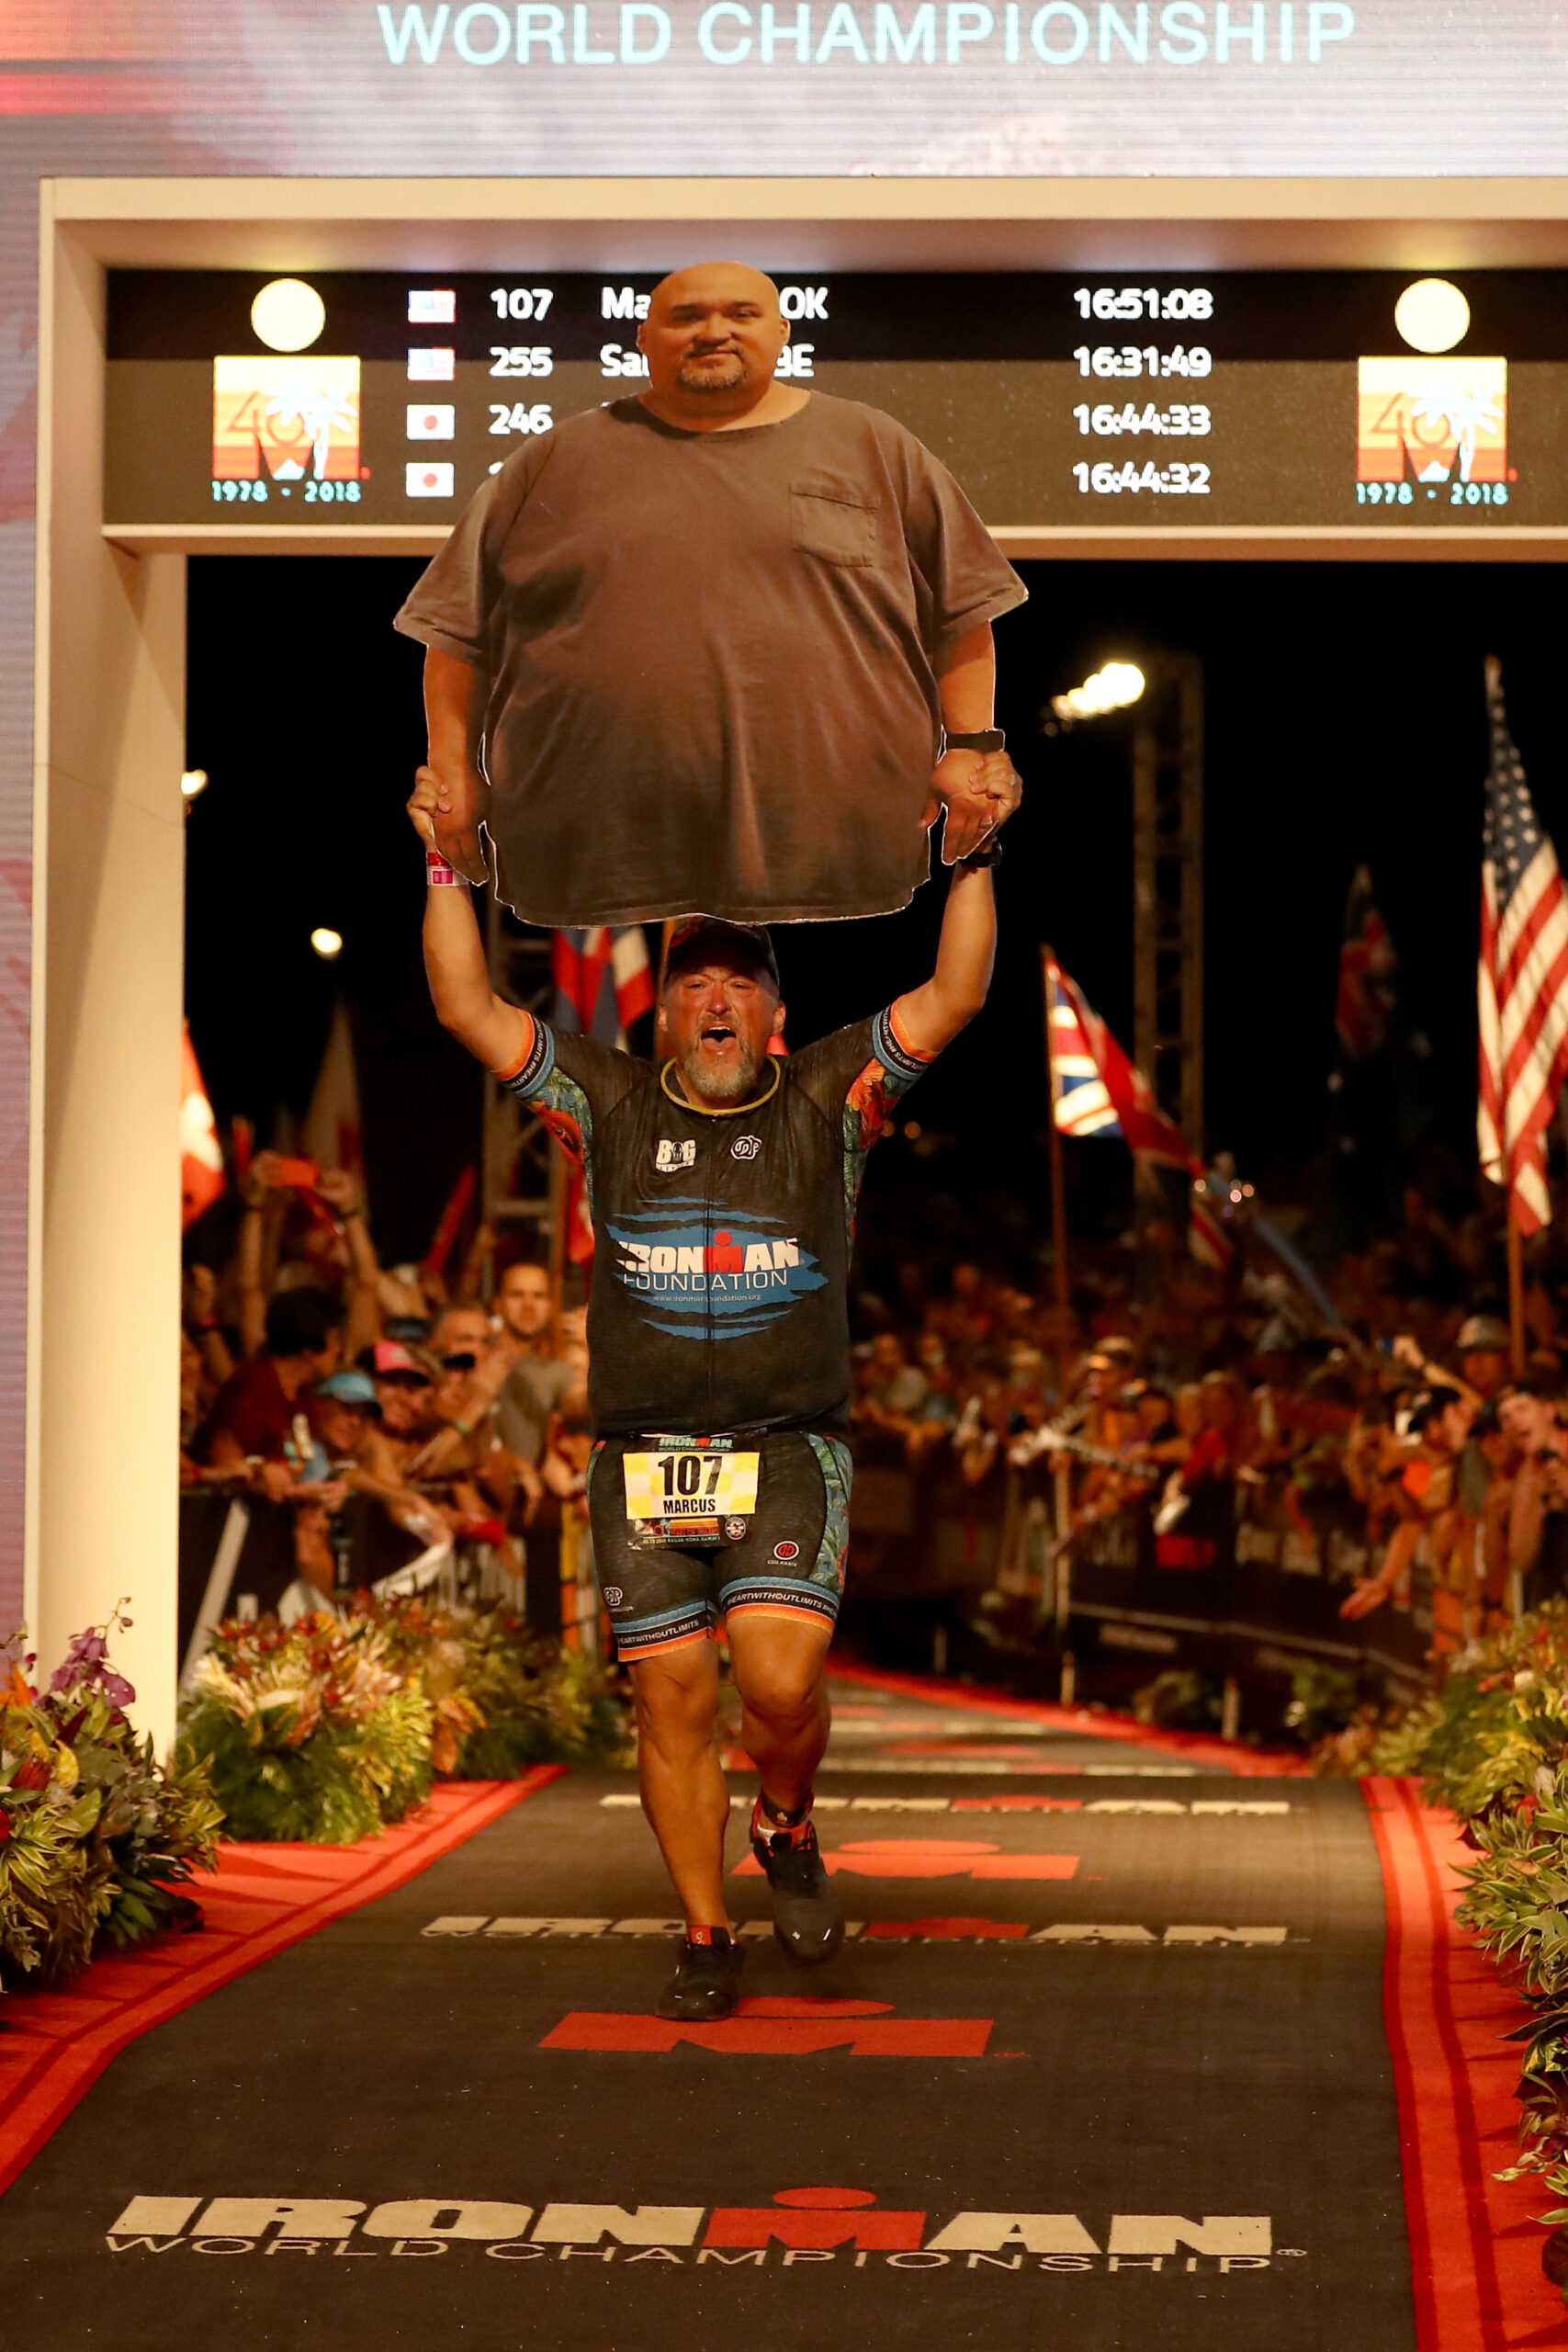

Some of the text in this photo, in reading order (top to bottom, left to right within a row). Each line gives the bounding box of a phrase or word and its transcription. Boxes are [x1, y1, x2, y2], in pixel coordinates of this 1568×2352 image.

[377, 1, 1357, 65] WORLD CHAMPIONSHIP
[490, 288, 554, 321] 107
[778, 286, 829, 320] OK
[1073, 288, 1214, 321] 16:51:08
[489, 345, 554, 378] 255
[1073, 345, 1213, 378] 16:31:49
[489, 402, 1213, 435] 246 16:44:33
[211, 480, 268, 503] 1978
[304, 481, 362, 503] 2018
[1071, 460, 1212, 493] 16:44:32
[1356, 482, 1415, 505] 1978
[1450, 482, 1509, 505] 2018
[615, 1231, 800, 1273] RONMAN
[658, 1437, 733, 1448] IRONMAN
[658, 1455, 722, 1496] 107
[663, 1498, 716, 1514] MARCUS
[106, 2187, 1273, 2255] IRONMAN
[105, 2235, 1273, 2275] WORLD CHAMPIONSHIP
